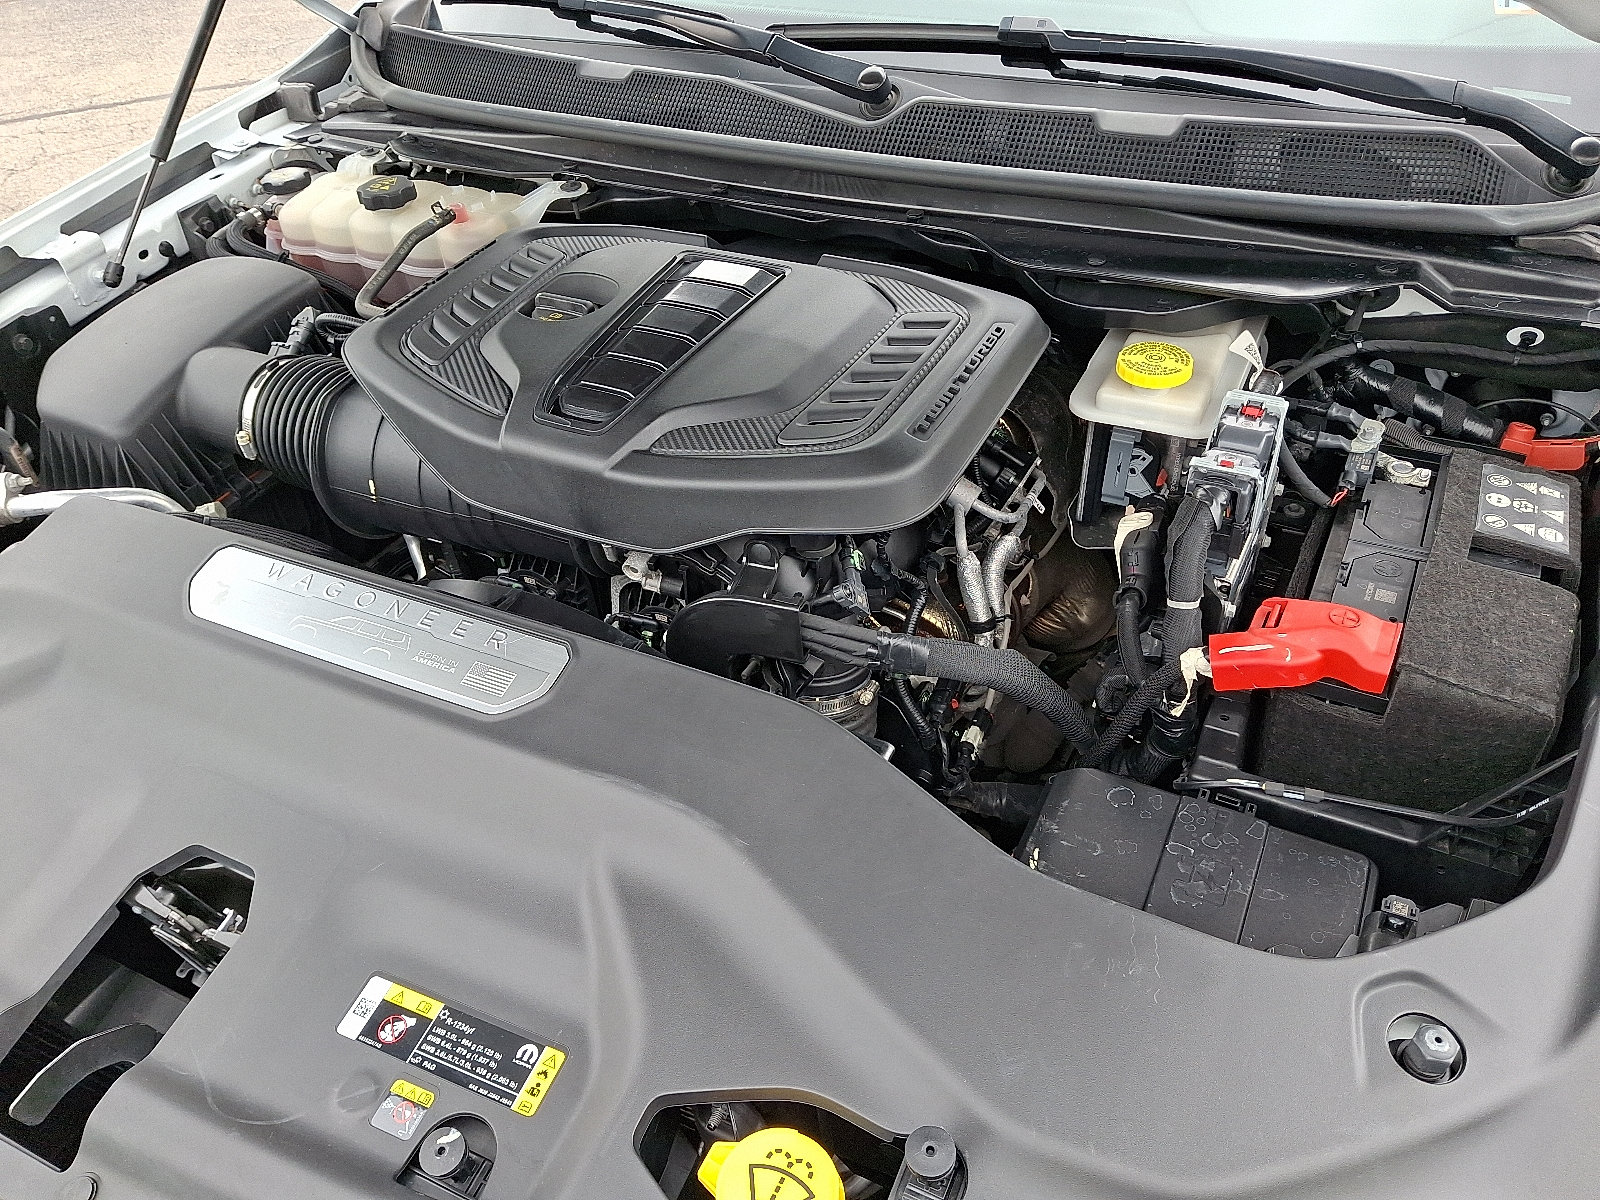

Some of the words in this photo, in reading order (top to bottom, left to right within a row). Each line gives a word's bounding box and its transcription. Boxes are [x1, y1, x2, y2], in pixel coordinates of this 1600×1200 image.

[268, 562, 510, 651] WAGONEER
[411, 655, 456, 674] AMERICA
[418, 650, 447, 664] BORN
[448, 659, 460, 668] IN
[445, 1018, 476, 1034] R-1234yf
